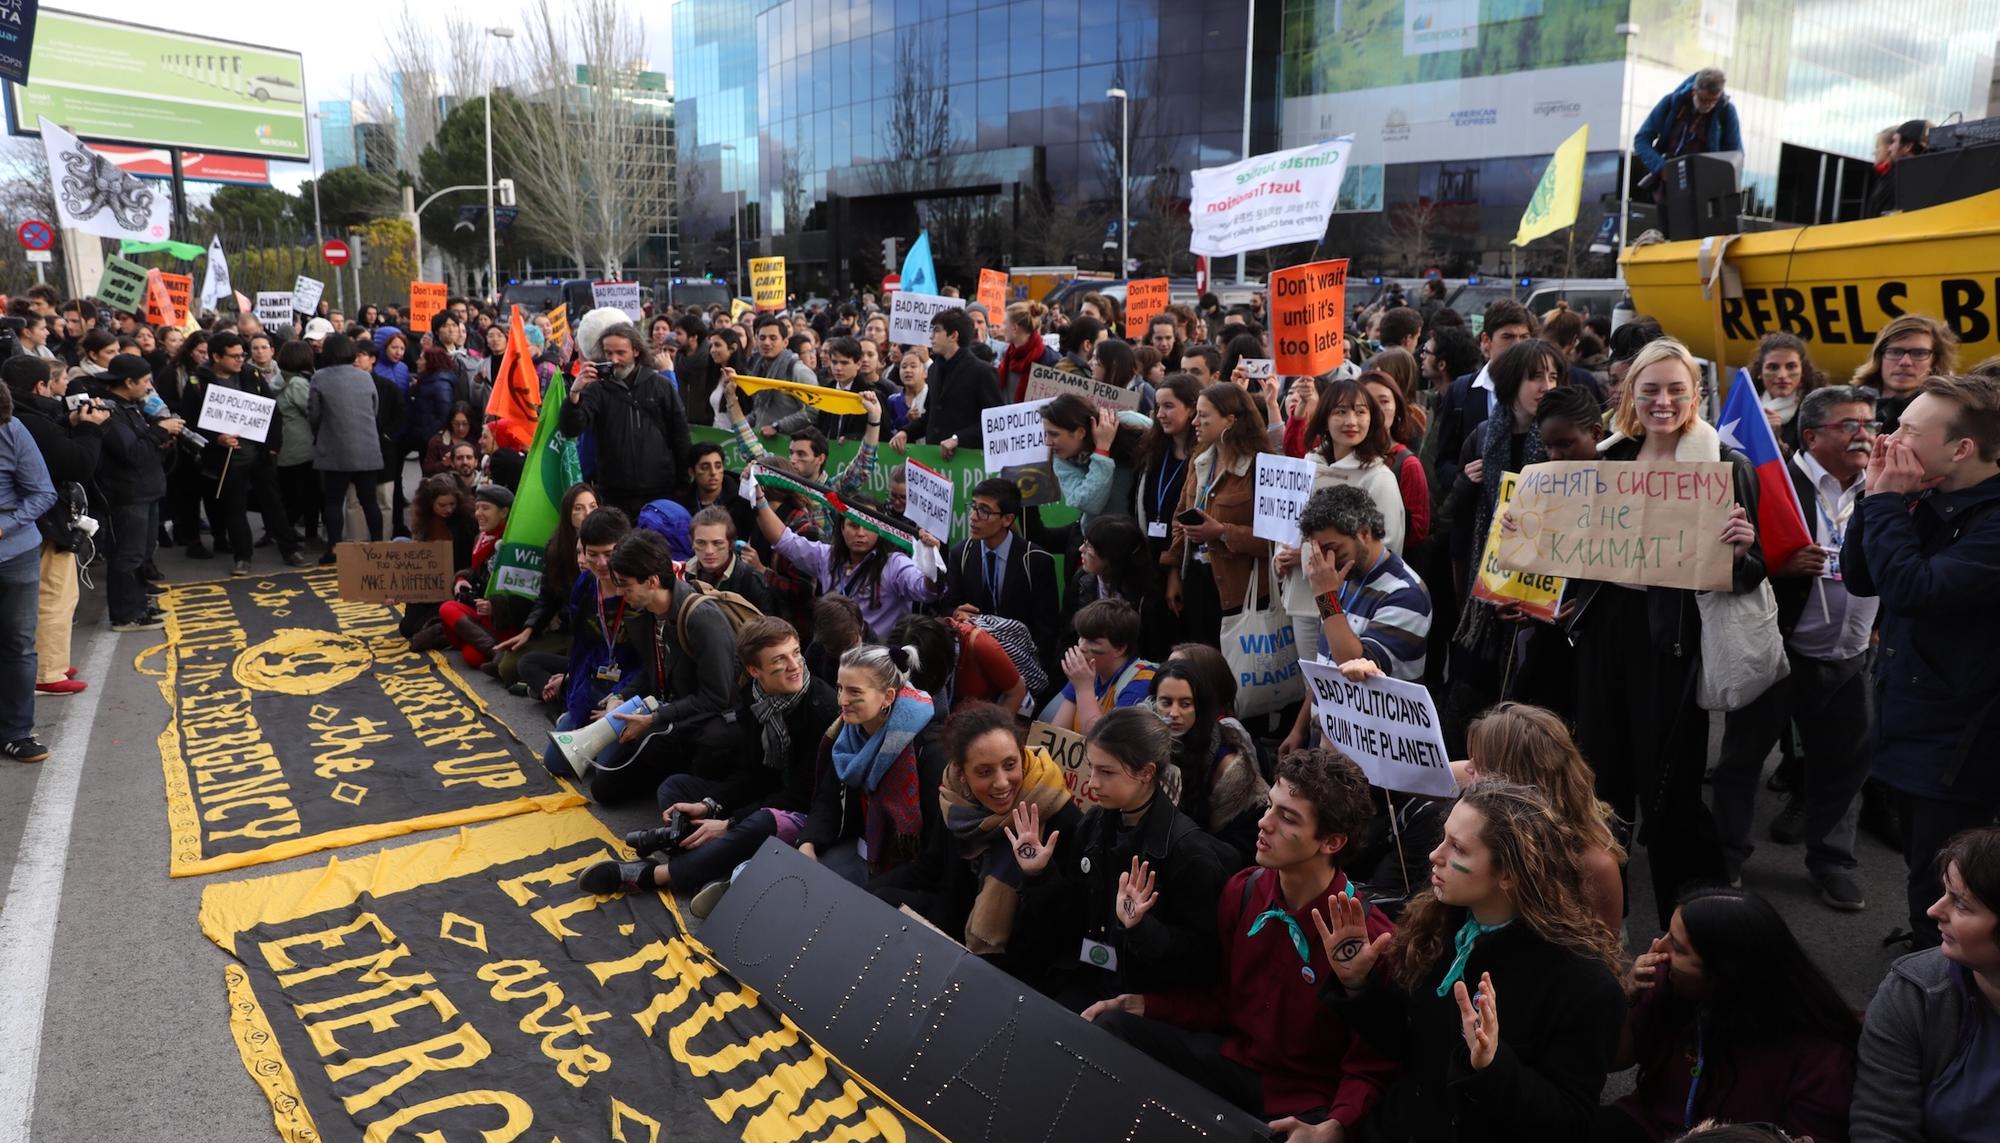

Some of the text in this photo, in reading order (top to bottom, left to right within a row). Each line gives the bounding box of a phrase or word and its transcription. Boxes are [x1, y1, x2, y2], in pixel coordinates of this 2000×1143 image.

[107, 261, 145, 282] Tomorrow
[754, 262, 783, 273] CLIMATE
[109, 279, 135, 292] will be
[755, 276, 783, 287] CAN'T
[1129, 281, 1168, 296] Don't wait
[1277, 266, 1345, 296] Don't wait
[260, 298, 291, 307] CLIMATE
[895, 299, 912, 313] BAD
[1131, 297, 1162, 310] until it's
[1283, 299, 1334, 326] until it's
[1722, 277, 2000, 345] REBELS B
[260, 310, 291, 319] CHANGE
[412, 313, 426, 321] too
[894, 318, 912, 330] RUIN
[914, 319, 928, 332] THE
[1128, 316, 1143, 326] too
[1279, 330, 1341, 356] too late.
[1093, 383, 1119, 400] PERO
[208, 391, 272, 415] BAD POLITICIANS
[205, 406, 223, 419] RUIN
[224, 410, 239, 424] THE
[986, 410, 1041, 433] BAD POLITIC
[989, 438, 1009, 455] RUIN
[1010, 434, 1026, 452] THE
[908, 469, 919, 487] BAD
[1259, 467, 1312, 495] BAD POLITICIANS
[918, 495, 928, 513] THE
[1258, 496, 1275, 516] RUIN
[1276, 498, 1287, 519] THE
[385, 550, 401, 560] ARE
[404, 549, 433, 560] NEVER
[514, 547, 542, 566] Wir
[376, 561, 438, 570] TOO SMALL TO
[361, 572, 386, 590] MAKE
[390, 571, 398, 590] A
[171, 584, 249, 660] CLIMATE
[1239, 625, 1295, 654] WIND
[1240, 661, 1299, 688] PLANE
[1313, 677, 1431, 728] BAD POLITICIANS
[308, 716, 394, 780] the
[1326, 714, 1444, 769] RUIN THE PLANET!
[181, 687, 302, 842] EMERGENCY
[432, 749, 528, 790] UP
[733, 873, 1207, 1143] CLIMAT
[258, 912, 563, 1143] EMERG
